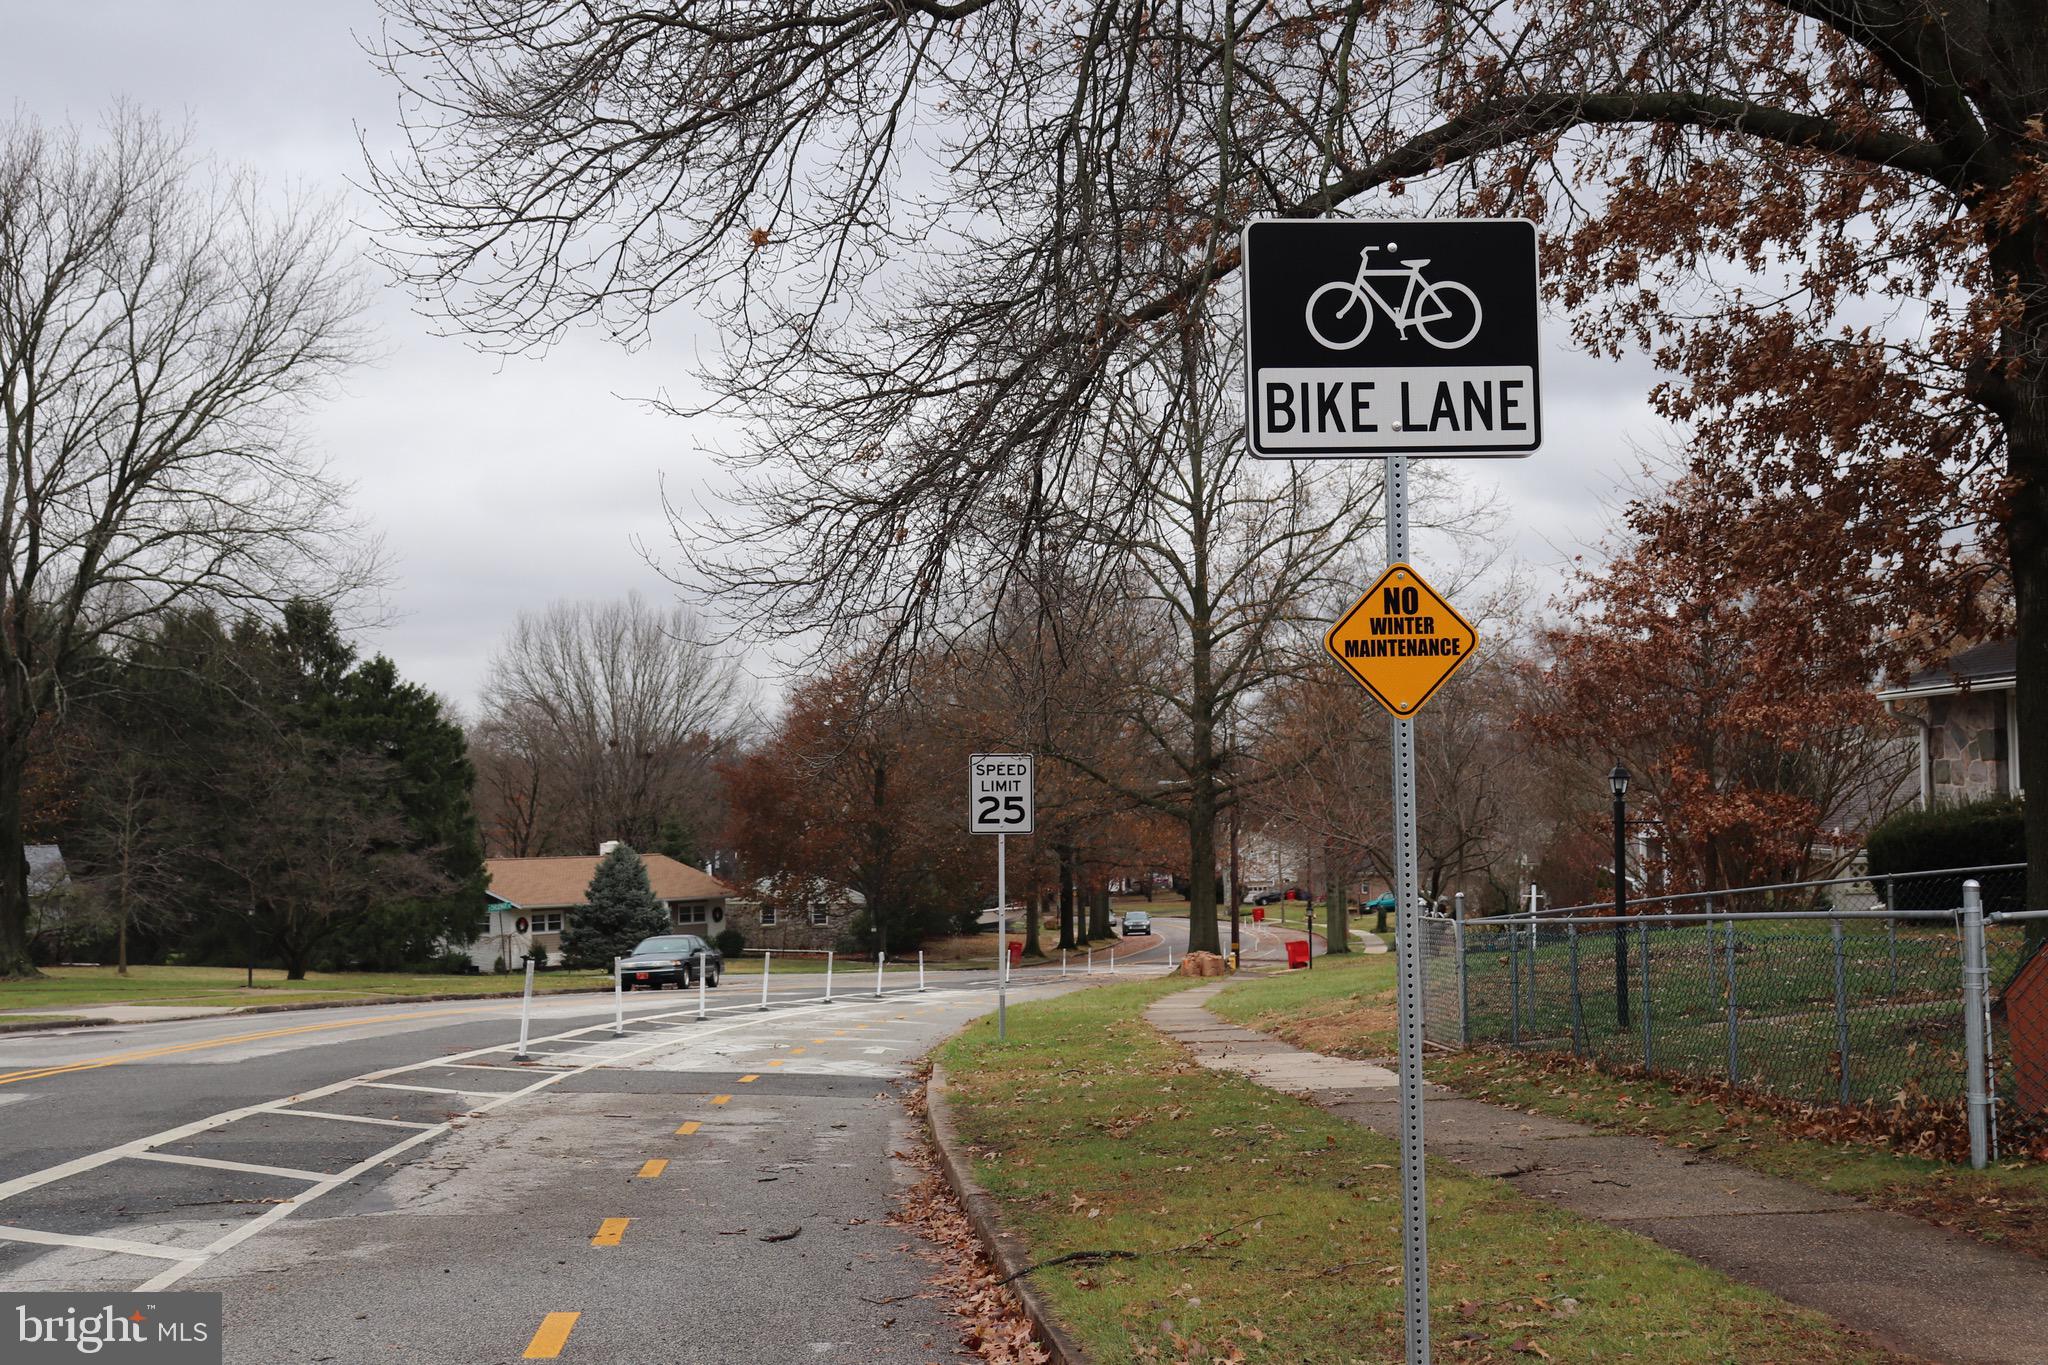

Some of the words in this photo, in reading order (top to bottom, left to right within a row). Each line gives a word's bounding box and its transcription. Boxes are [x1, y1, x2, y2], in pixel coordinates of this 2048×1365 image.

[1266, 382, 1378, 433] BIKE
[1401, 380, 1527, 432] LANE
[1383, 586, 1419, 615] NO
[1370, 616, 1434, 635] WINTER
[1344, 638, 1461, 658] MAINTENANCE
[976, 764, 1027, 776] SPEED
[981, 780, 1021, 792] LIMIT
[978, 796, 1025, 824] 25
